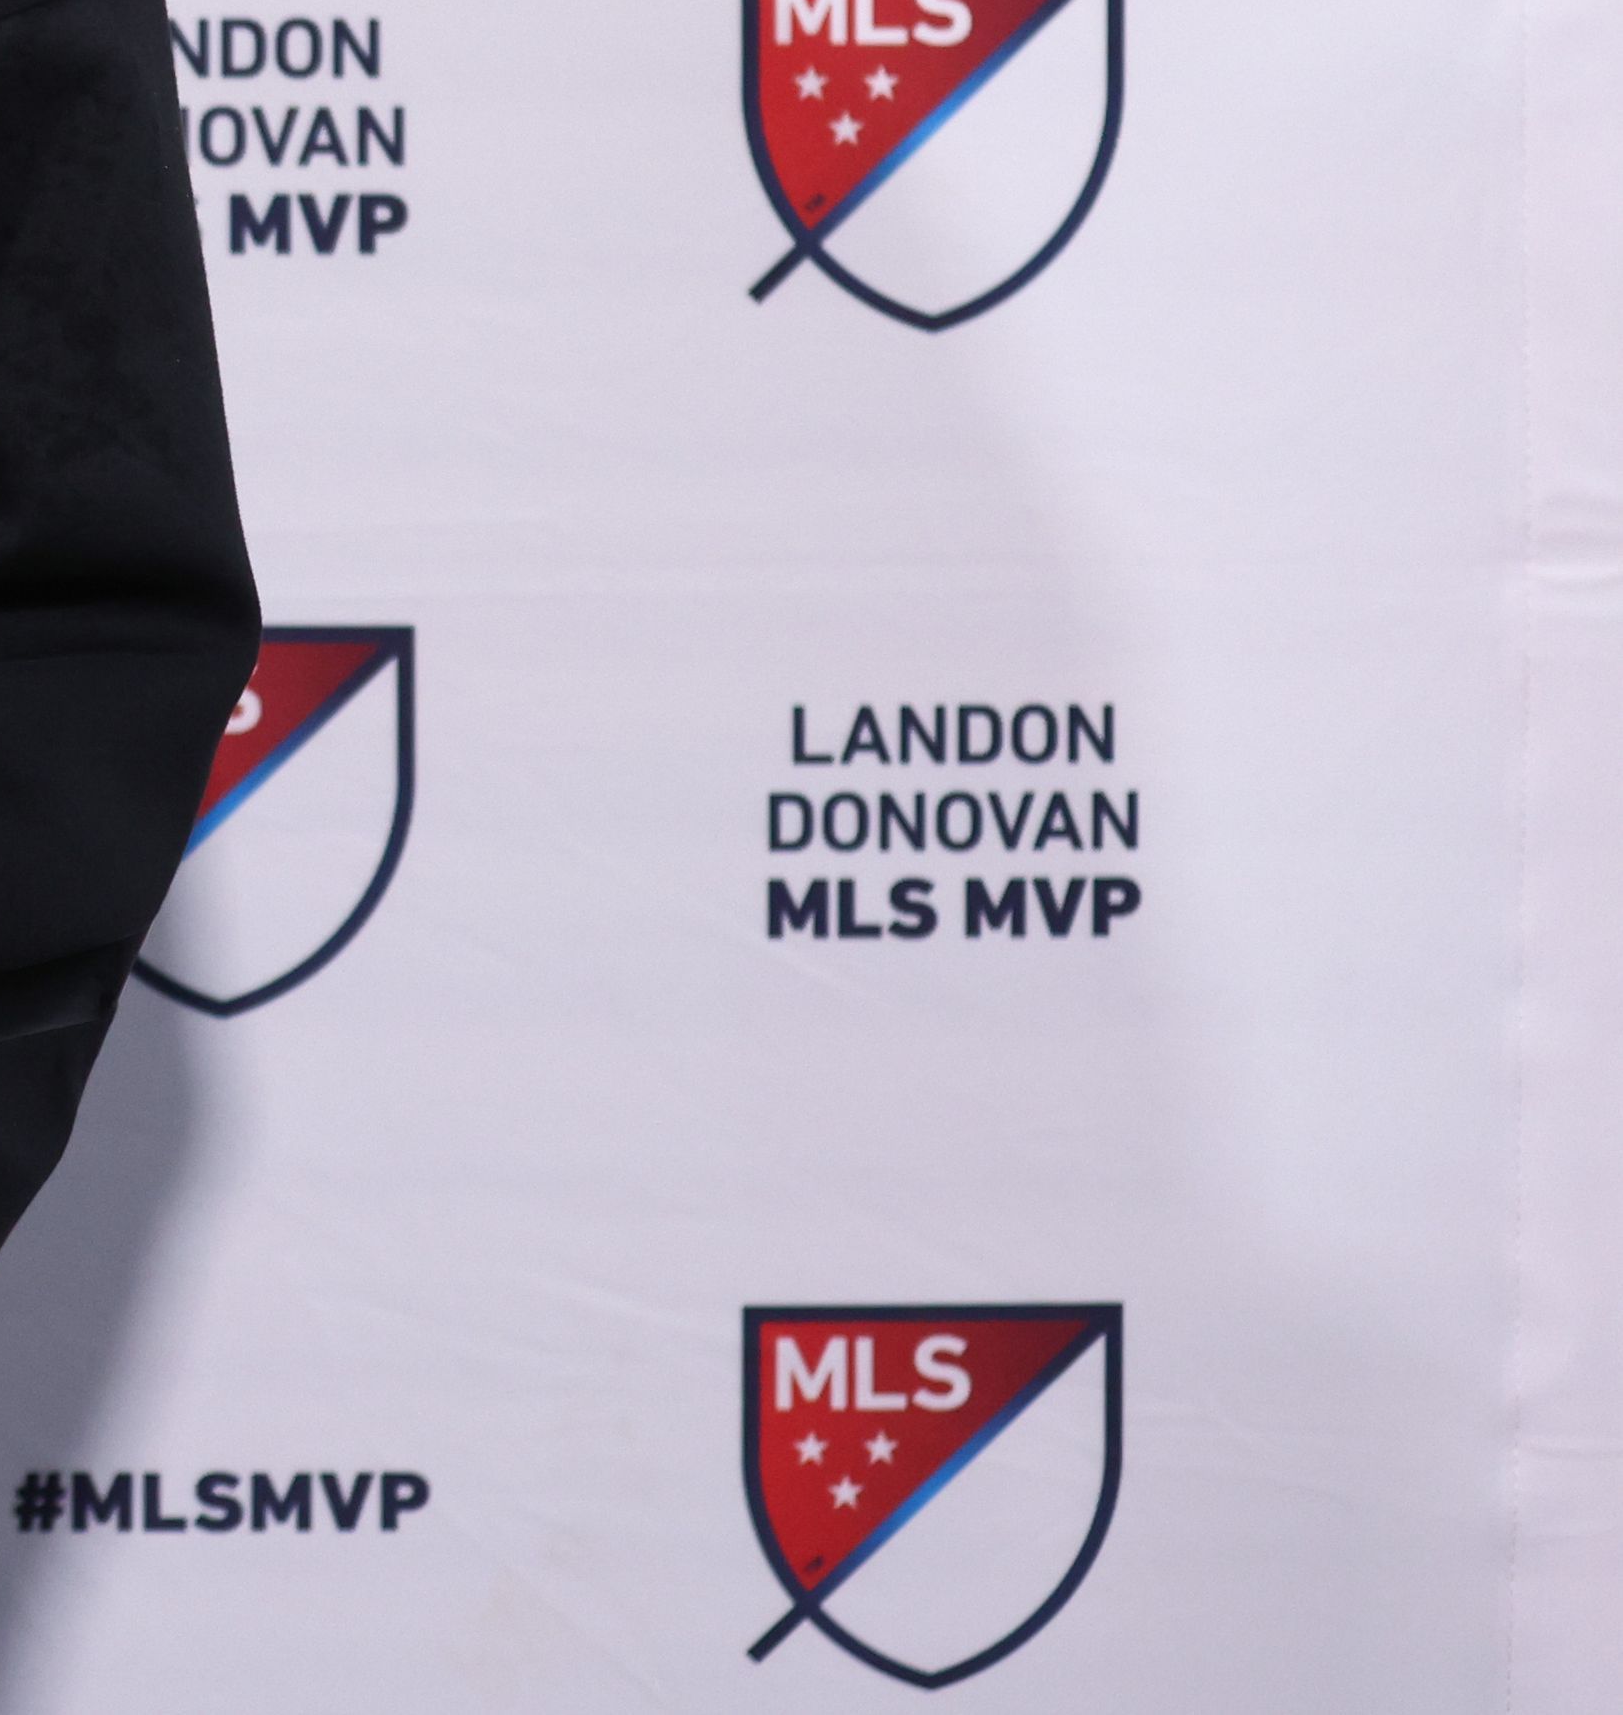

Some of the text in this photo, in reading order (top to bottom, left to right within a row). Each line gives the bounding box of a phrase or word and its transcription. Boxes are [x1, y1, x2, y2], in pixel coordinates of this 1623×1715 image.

[169, 17, 381, 79] NDON
[182, 105, 406, 167] OVAN
[229, 193, 409, 256] MVP
[791, 702, 1115, 766] LANDON
[767, 790, 1139, 853] DONOVAN
[766, 875, 1142, 940] MLS MVP
[773, 1335, 971, 1413] MLS
[13, 1470, 431, 1533] #MLSMVP
